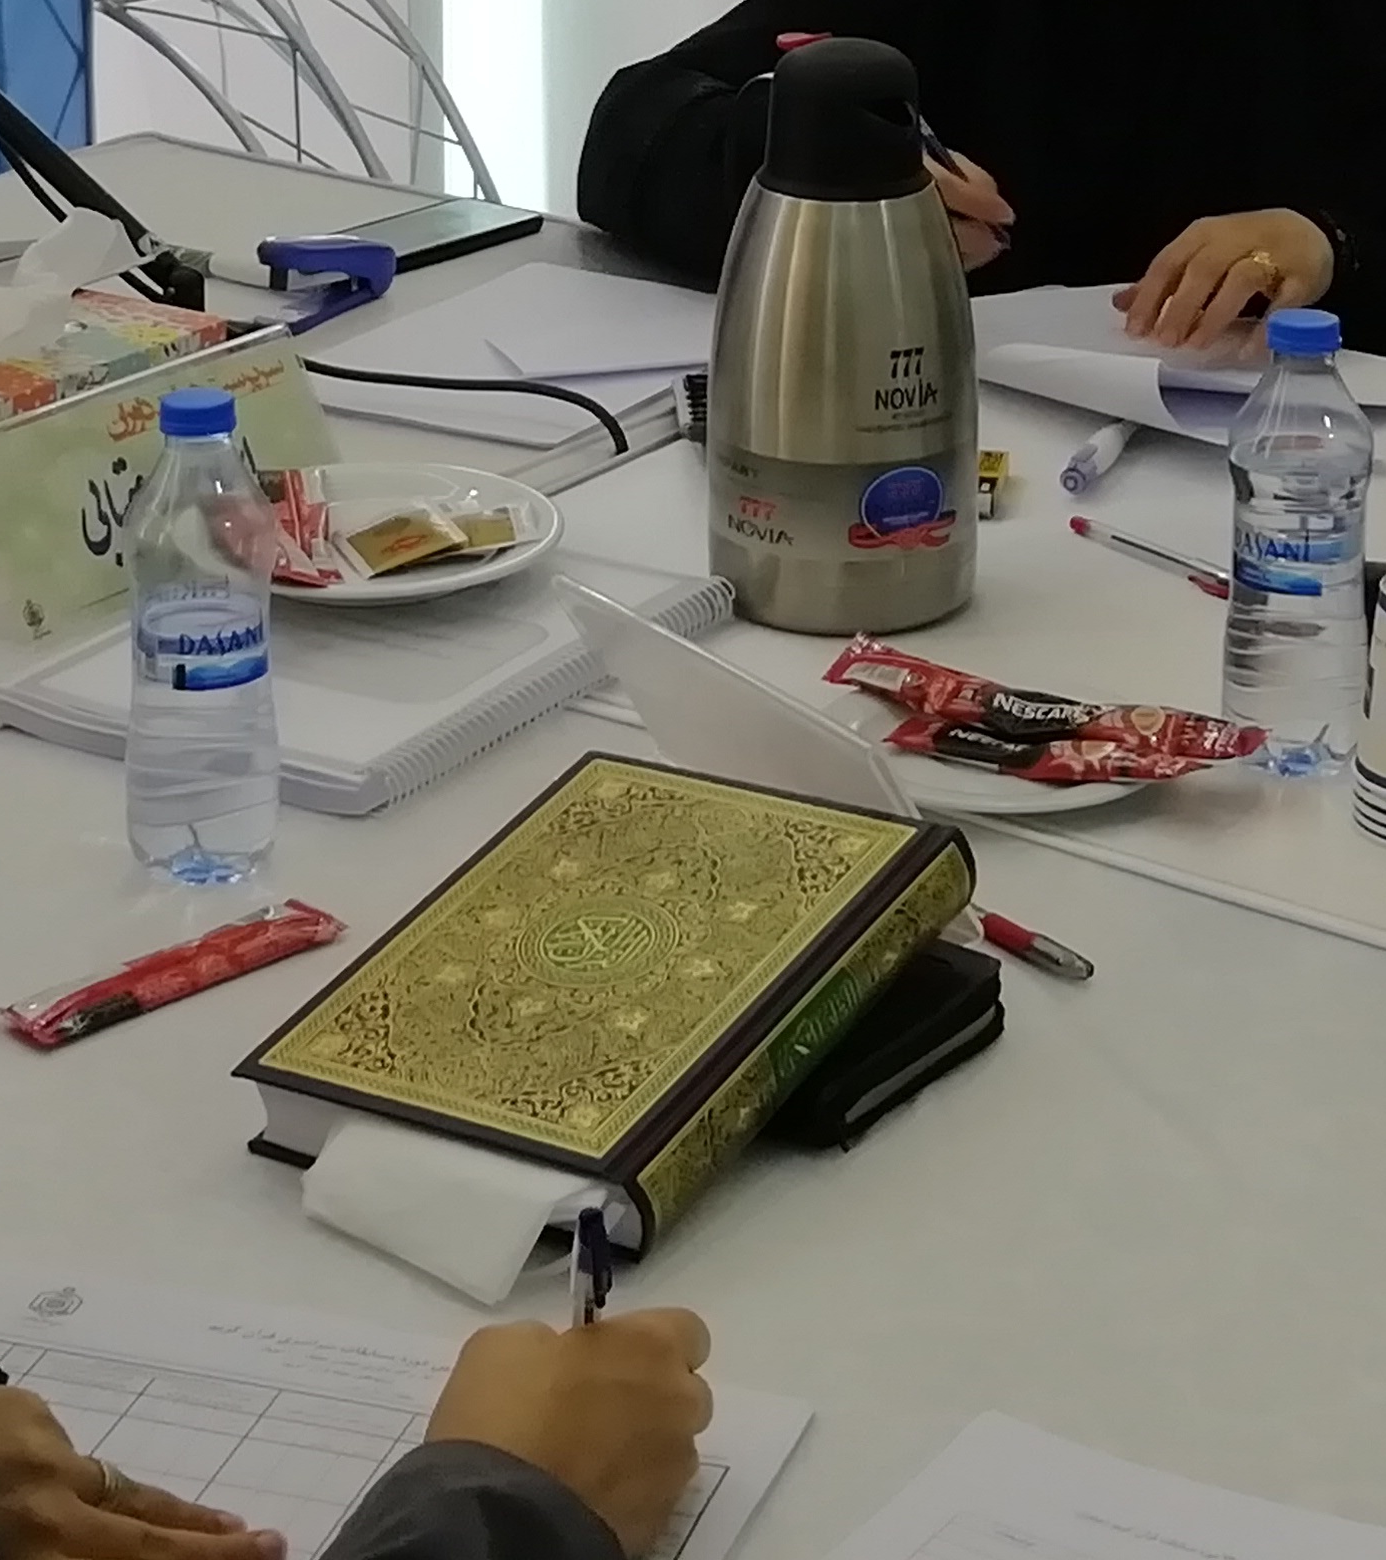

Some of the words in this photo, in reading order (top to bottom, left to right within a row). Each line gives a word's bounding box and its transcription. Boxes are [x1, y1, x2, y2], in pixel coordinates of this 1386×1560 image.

[890, 346, 924, 379] 777
[874, 379, 938, 410] NOVIA
[728, 514, 794, 546] NOVIA
